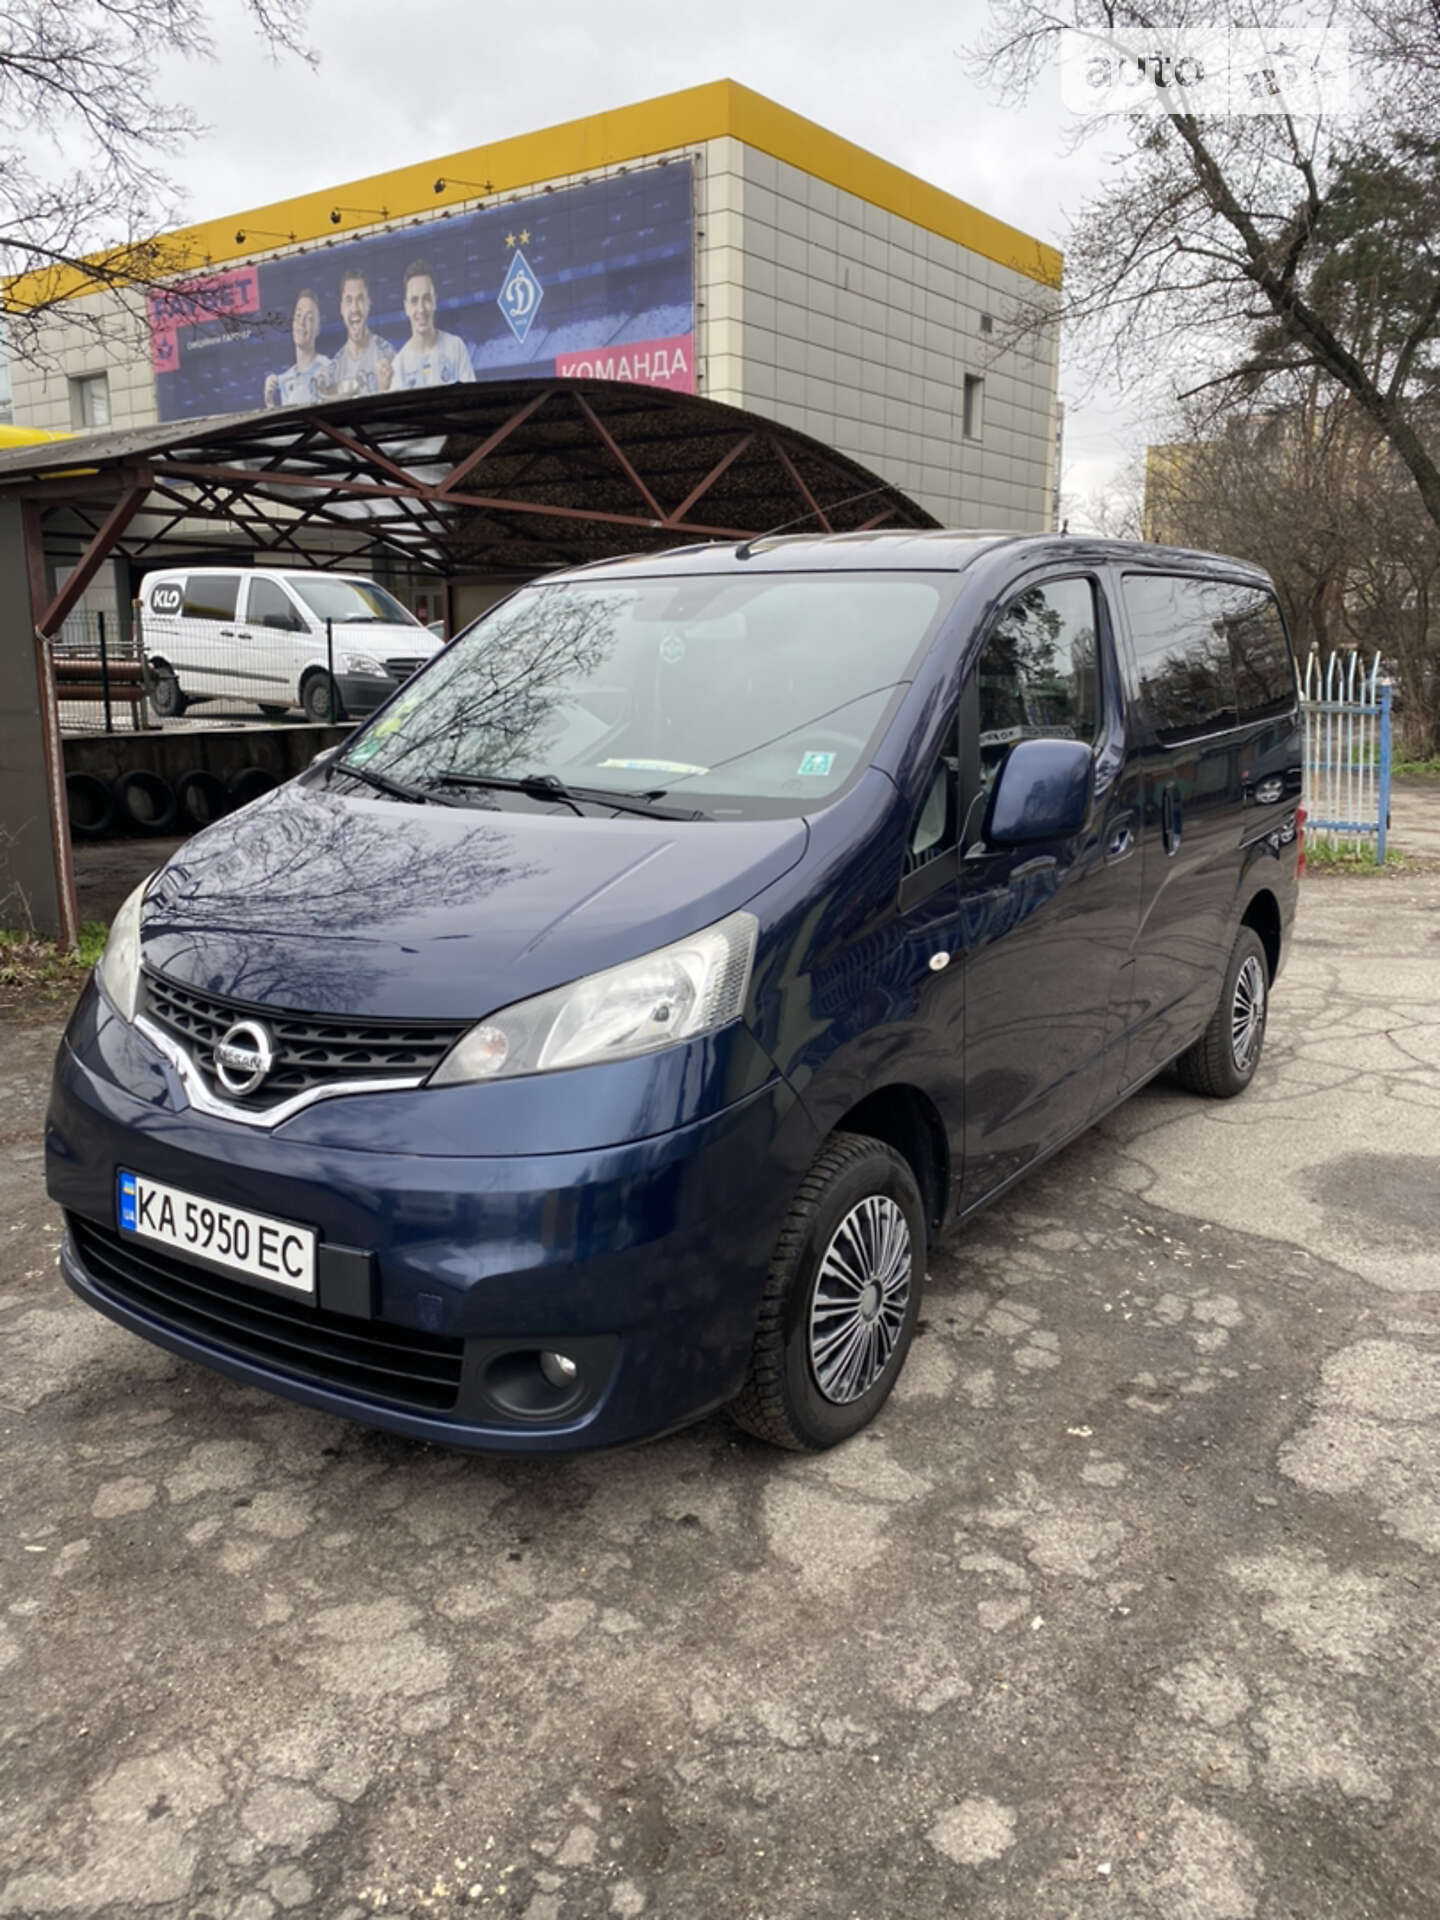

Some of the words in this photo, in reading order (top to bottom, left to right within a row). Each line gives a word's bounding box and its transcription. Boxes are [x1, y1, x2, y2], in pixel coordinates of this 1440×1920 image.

[562, 348, 688, 381] КОМАНДА
[153, 590, 180, 607] KLO
[139, 1186, 177, 1237] KA
[185, 1202, 250, 1260] 5950
[258, 1225, 304, 1278] EC
